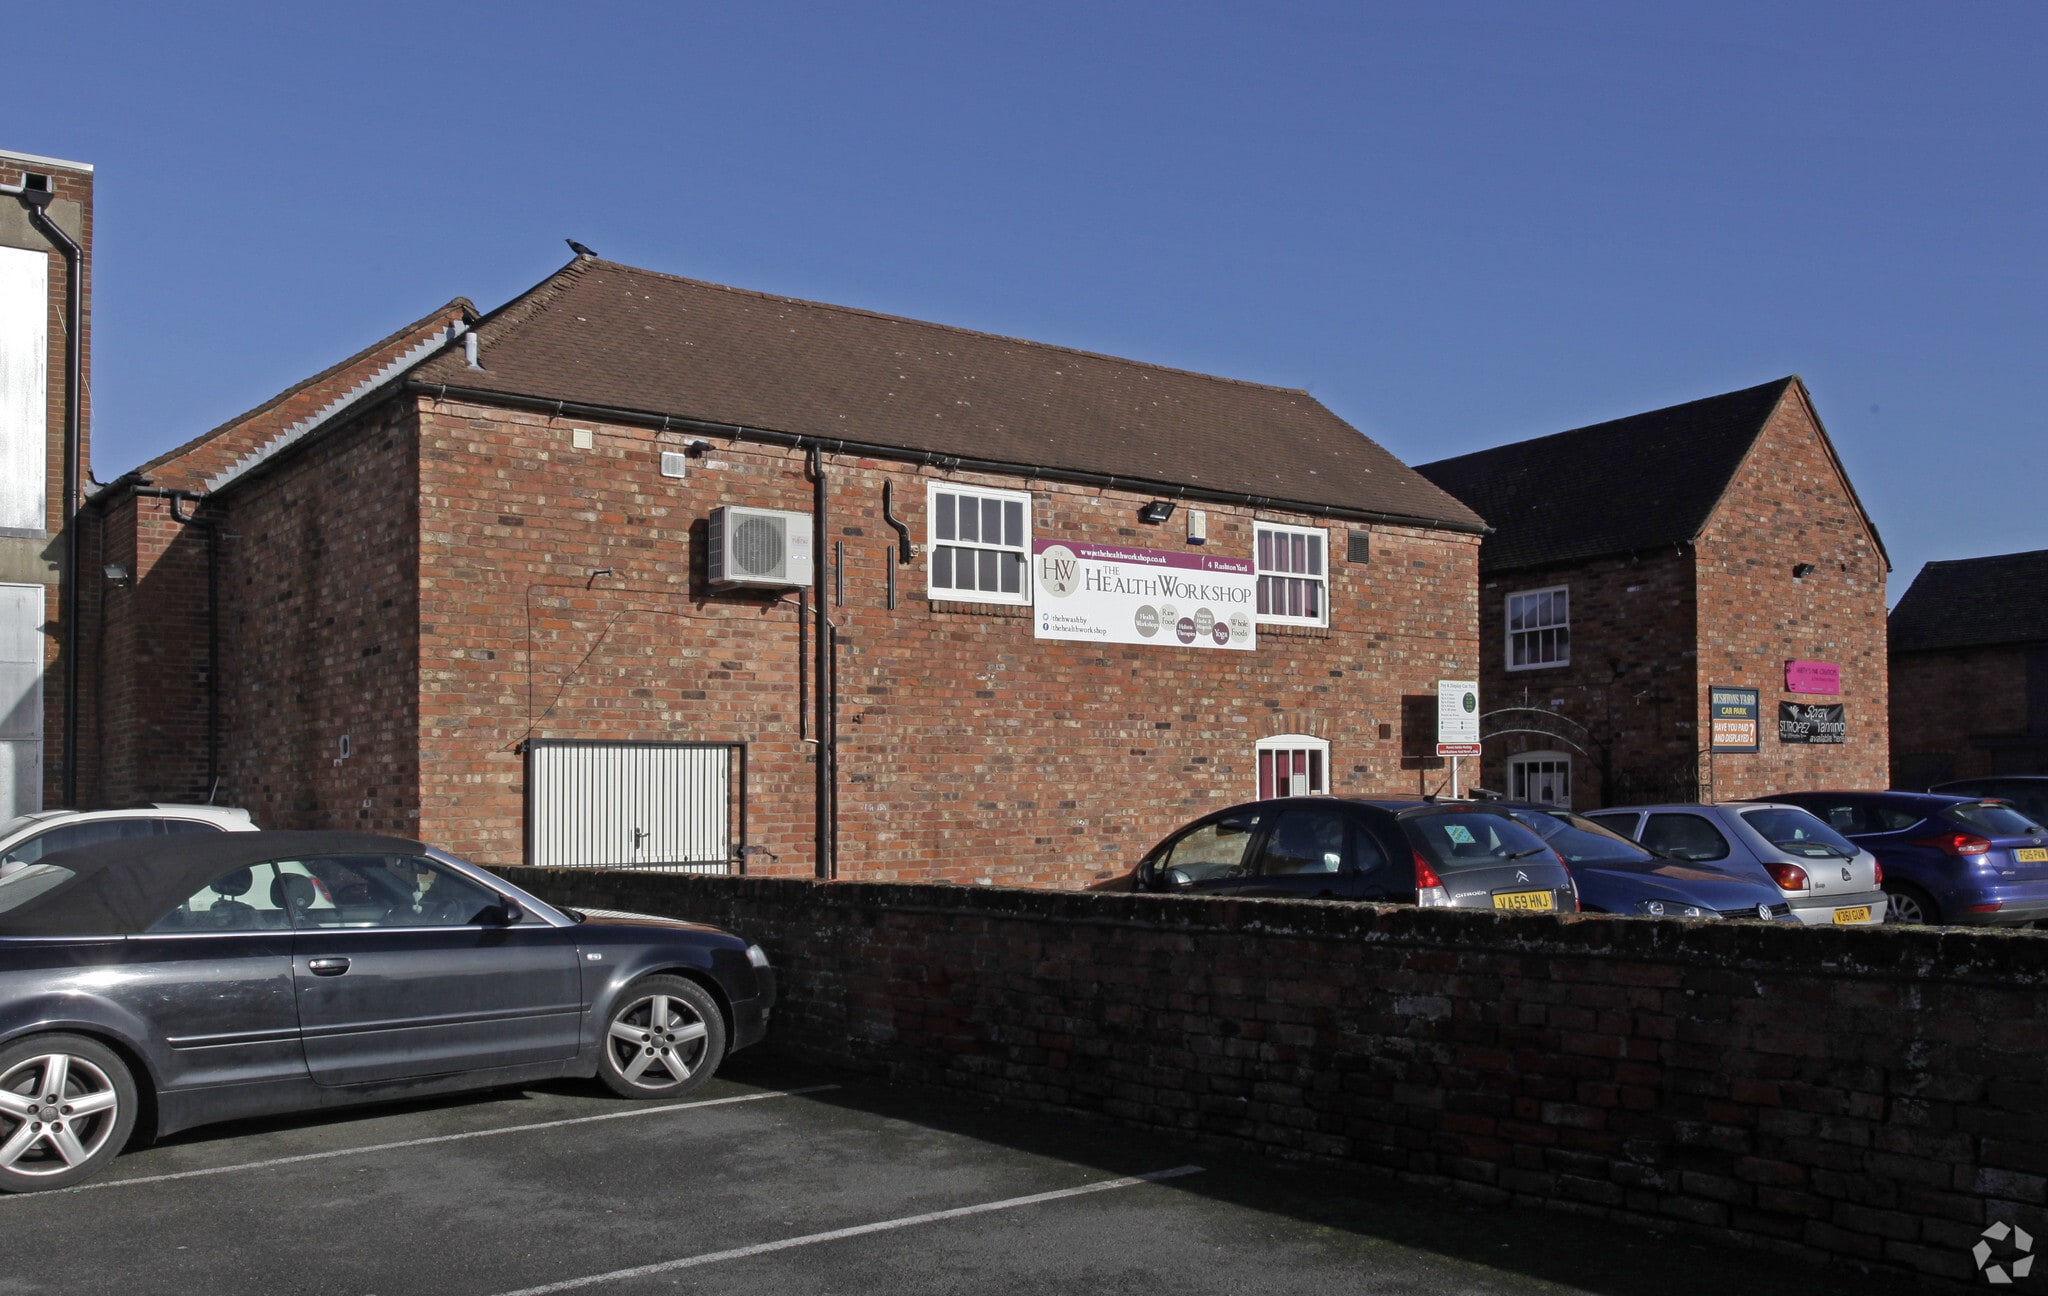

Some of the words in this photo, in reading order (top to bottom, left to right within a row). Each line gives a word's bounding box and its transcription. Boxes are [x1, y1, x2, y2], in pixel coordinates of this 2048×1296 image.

[1103, 565, 1120, 575] THE
[1207, 561, 1212, 569] 4
[1236, 563, 1248, 572] Yard
[1162, 608, 1174, 616] Raw
[1230, 618, 1248, 627] Whole
[1214, 629, 1228, 640] Yoga
[1231, 628, 1247, 637] Foods
[1721, 707, 1733, 715] CAR
[1733, 707, 1747, 715] PARK
[1804, 705, 1830, 721] Spray
[1714, 722, 1727, 731] HAVE
[1728, 723, 1738, 731] YOU
[1738, 723, 1749, 732] PAID
[1814, 719, 1846, 736] Tanning
[1714, 733, 1725, 742] AND
[1725, 734, 1750, 743] DISPLAYED
[1809, 734, 1832, 743] available
[1499, 895, 1528, 909] VA59
[1530, 894, 1548, 908] HNJ
[1836, 910, 1852, 922] V361
